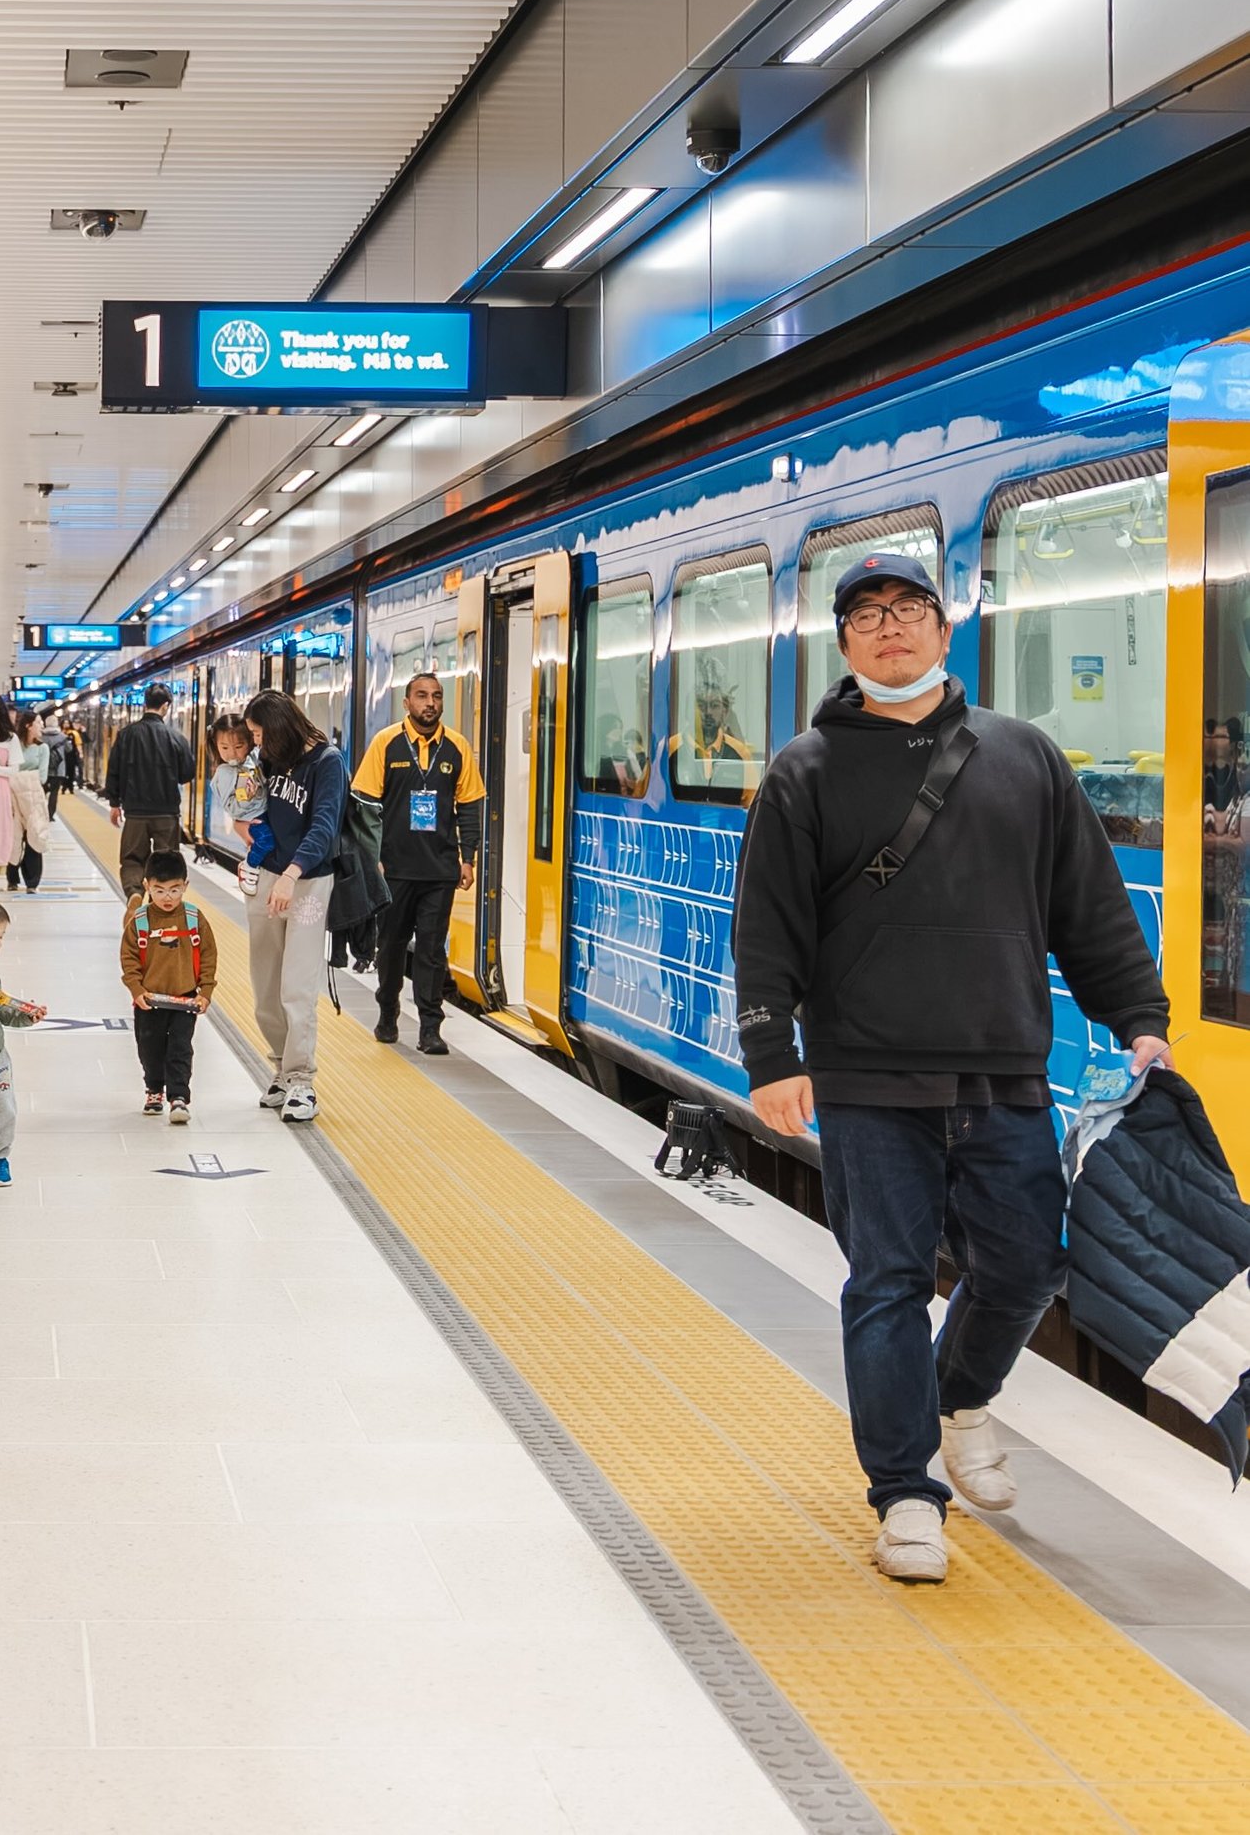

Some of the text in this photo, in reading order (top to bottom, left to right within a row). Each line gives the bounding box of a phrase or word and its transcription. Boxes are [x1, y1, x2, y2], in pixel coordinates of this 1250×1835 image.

[134, 313, 161, 387] 1
[280, 330, 339, 349] Thank
[342, 334, 379, 352] you
[381, 331, 410, 349] for
[280, 351, 357, 372] visiting.
[393, 353, 414, 370] te
[30, 625, 40, 648] 1
